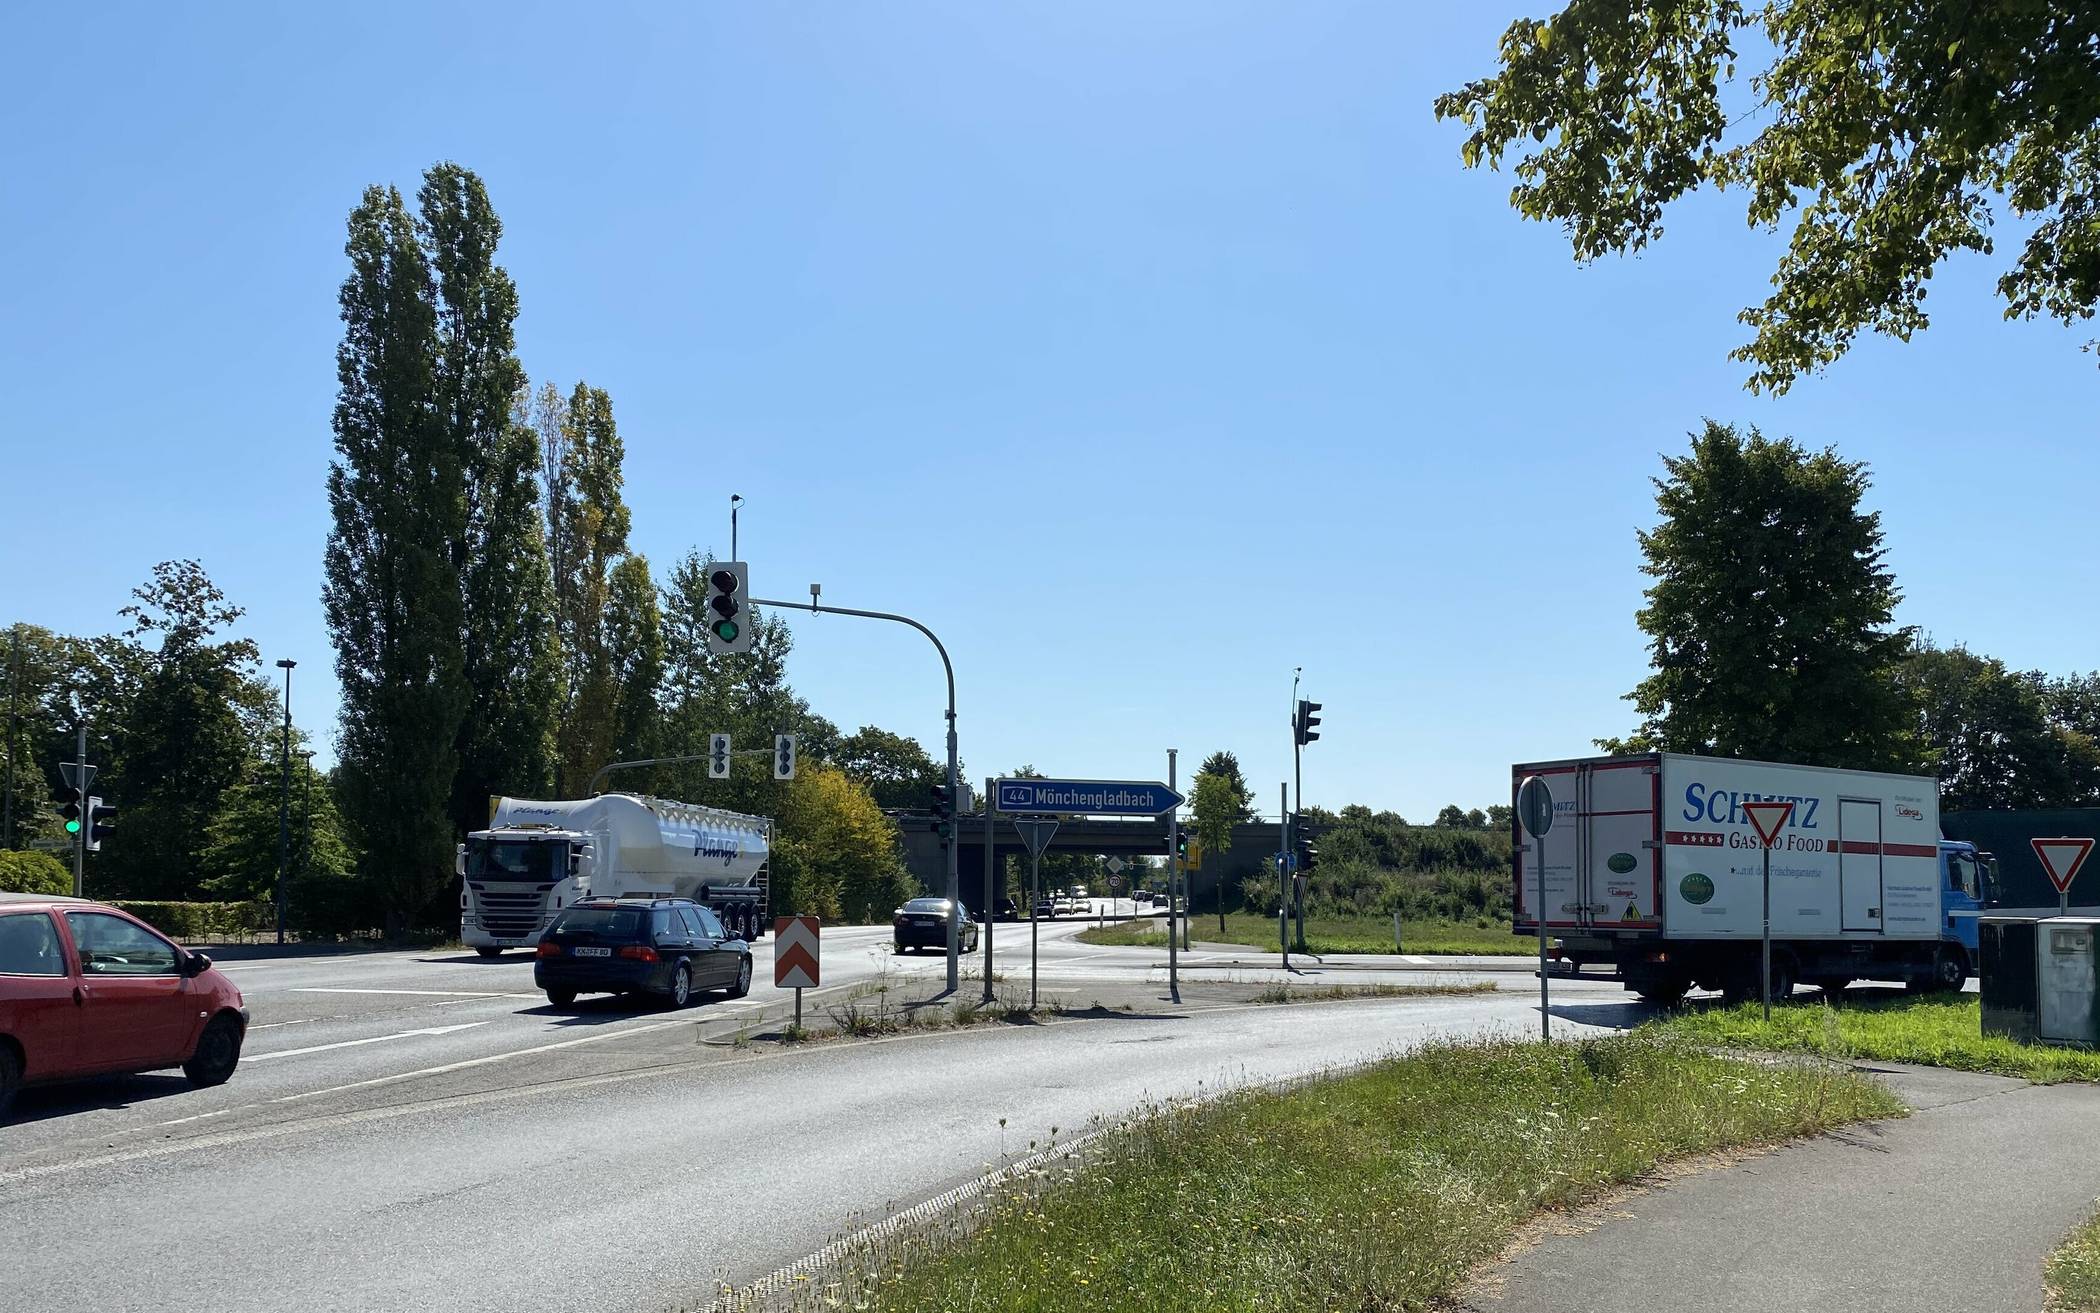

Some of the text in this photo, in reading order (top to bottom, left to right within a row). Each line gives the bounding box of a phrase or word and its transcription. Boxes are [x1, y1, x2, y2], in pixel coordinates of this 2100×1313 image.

[1009, 788, 1154, 809] 44 Mönchengladbach
[1683, 782, 1819, 828] SCHTZ
[1787, 834, 1823, 852] FOOD
